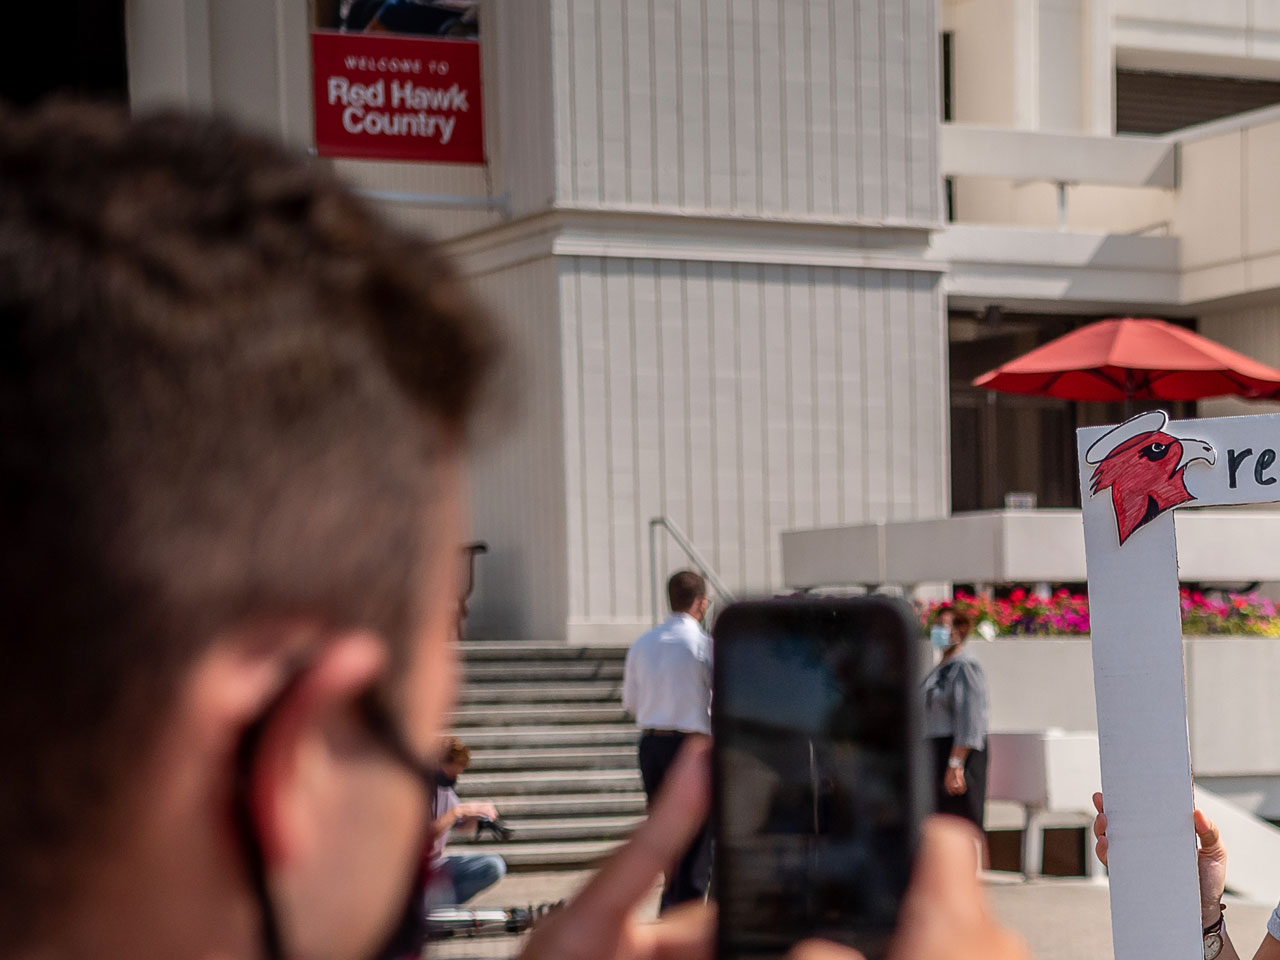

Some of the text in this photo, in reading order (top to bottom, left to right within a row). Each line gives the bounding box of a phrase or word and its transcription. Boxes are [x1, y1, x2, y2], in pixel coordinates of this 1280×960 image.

[344, 56, 450, 75] WELCOME TO
[327, 75, 469, 112] Red Hawk
[342, 105, 456, 145] Country
